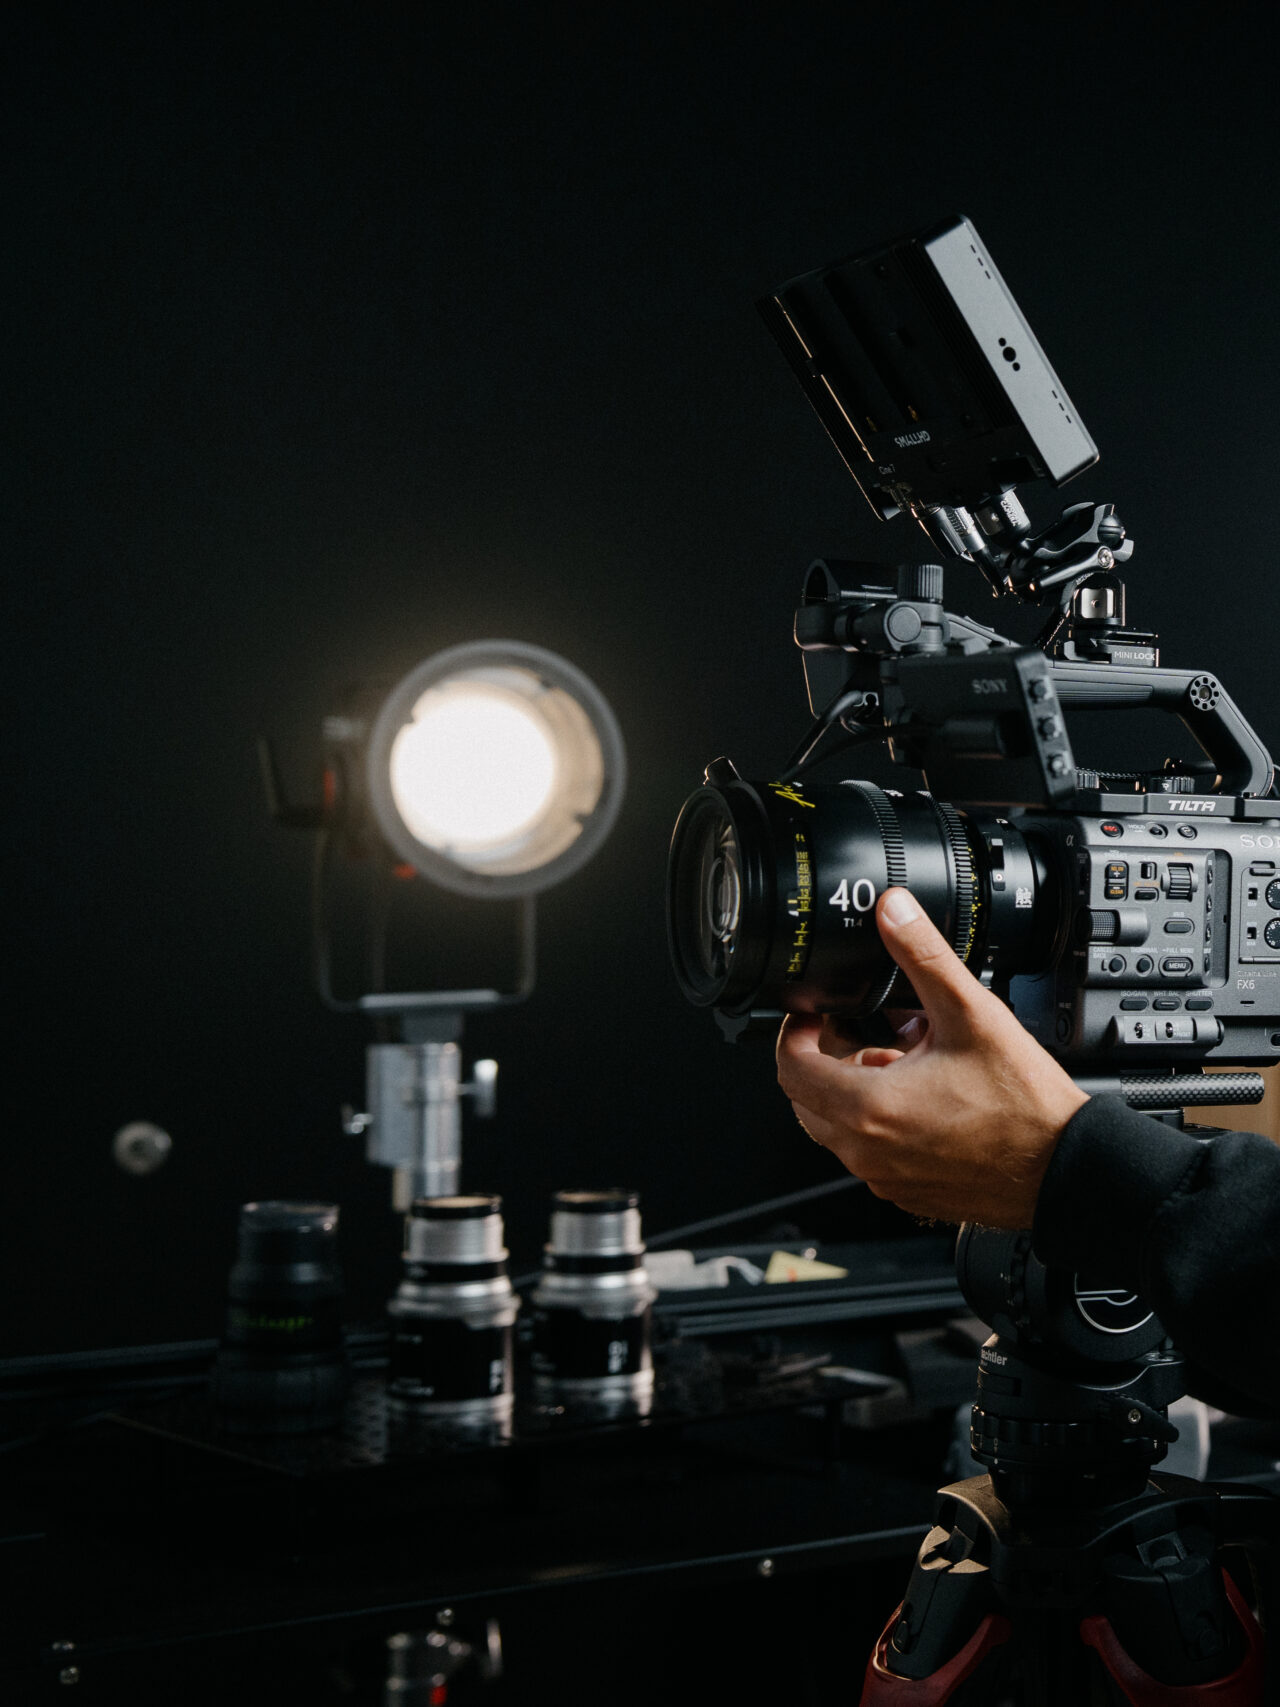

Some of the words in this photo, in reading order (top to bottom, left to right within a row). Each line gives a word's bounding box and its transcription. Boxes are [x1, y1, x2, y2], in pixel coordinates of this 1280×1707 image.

[894, 430, 931, 448] SMALLHD
[1114, 651, 1132, 660] MINI
[1133, 652, 1156, 661] LOCK
[972, 679, 1008, 694] SONY
[1168, 800, 1216, 812] TILTA
[828, 878, 876, 912] 40
[1237, 979, 1255, 990] FX6
